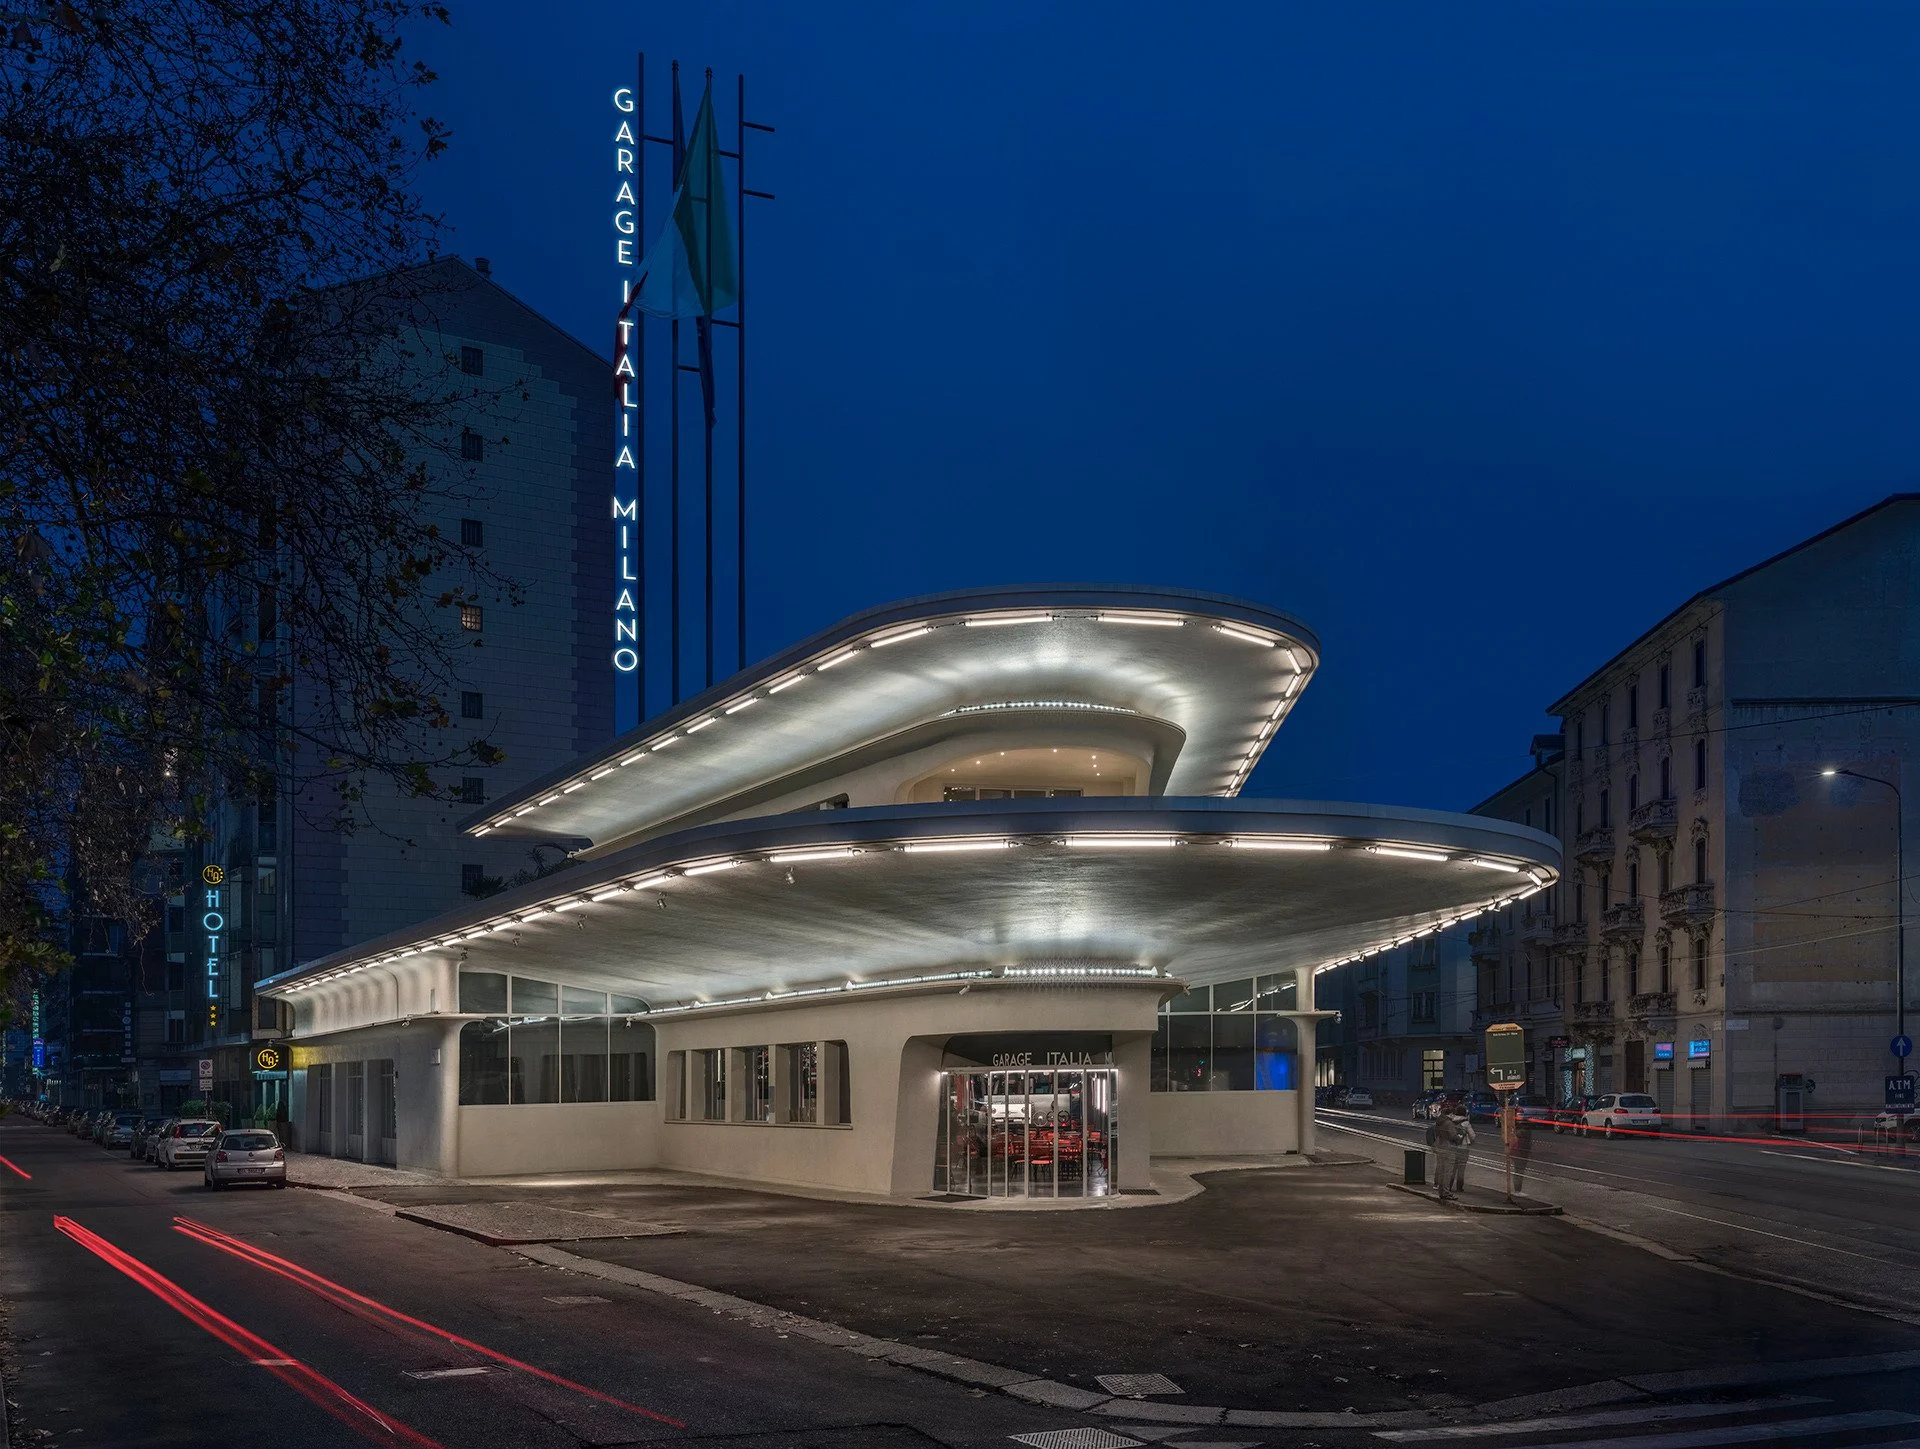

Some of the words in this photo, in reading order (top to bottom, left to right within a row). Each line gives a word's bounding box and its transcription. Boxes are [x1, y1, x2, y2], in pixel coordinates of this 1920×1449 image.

[614, 88, 635, 265] GARAGE
[615, 280, 637, 469] ITALIA
[613, 497, 638, 671] MILANO
[203, 889, 224, 998] HOTEL
[992, 1052, 1032, 1067] GARAGE
[1047, 1052, 1093, 1067] ITALIA
[1888, 1080, 1911, 1090] ATM
